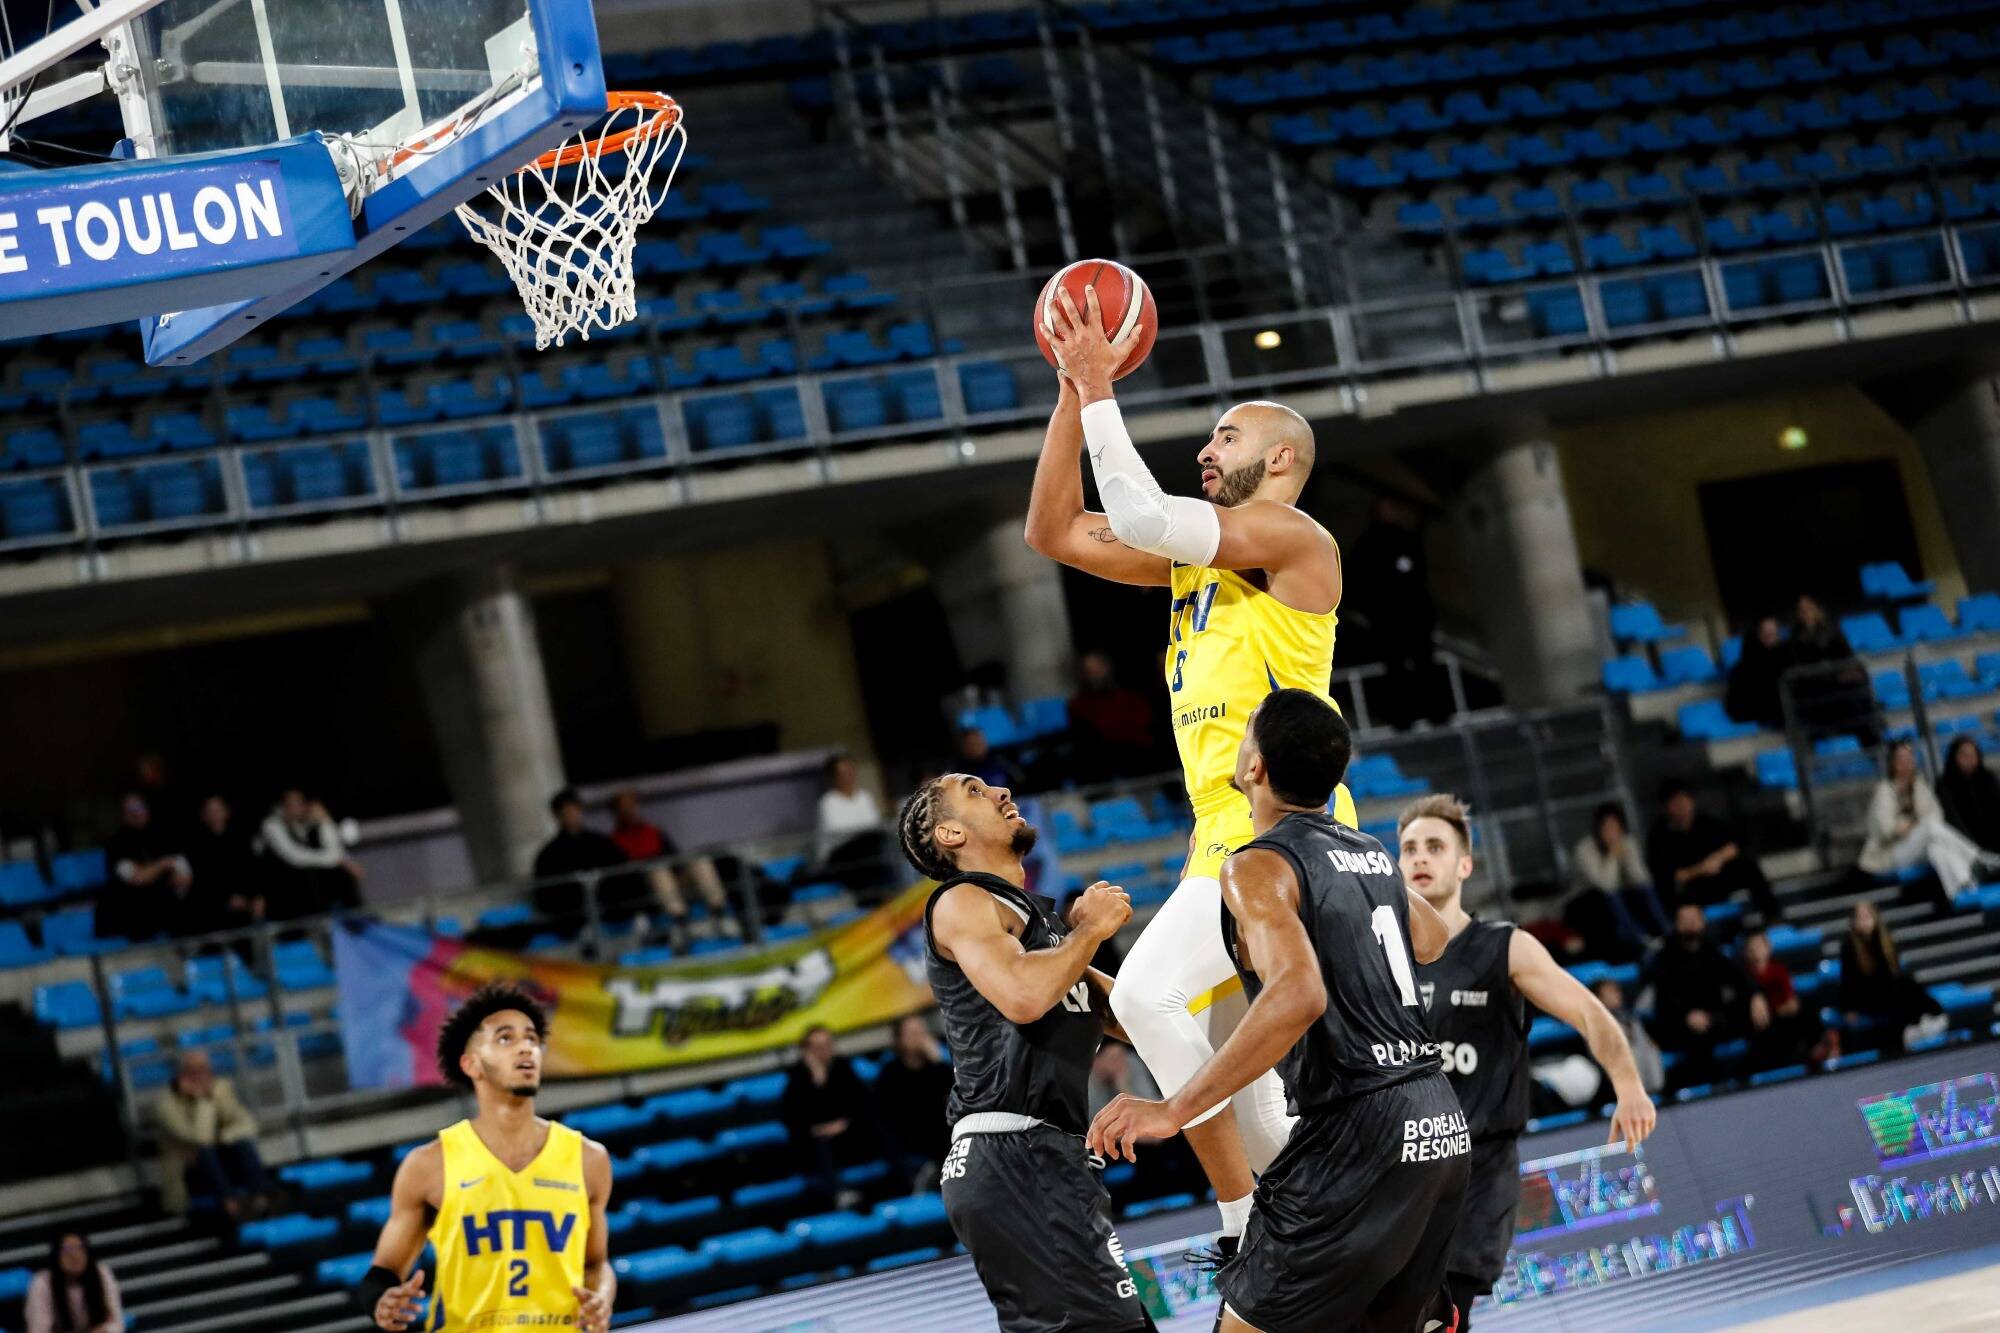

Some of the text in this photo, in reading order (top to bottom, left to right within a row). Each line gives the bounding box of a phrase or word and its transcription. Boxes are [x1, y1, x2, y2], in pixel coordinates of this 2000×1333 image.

[36, 179, 283, 267] TOULON
[1326, 849, 1394, 876] LYONSO
[1371, 905, 1418, 1006] 1
[462, 1209, 577, 1257] HTV
[509, 1259, 529, 1297] 2
